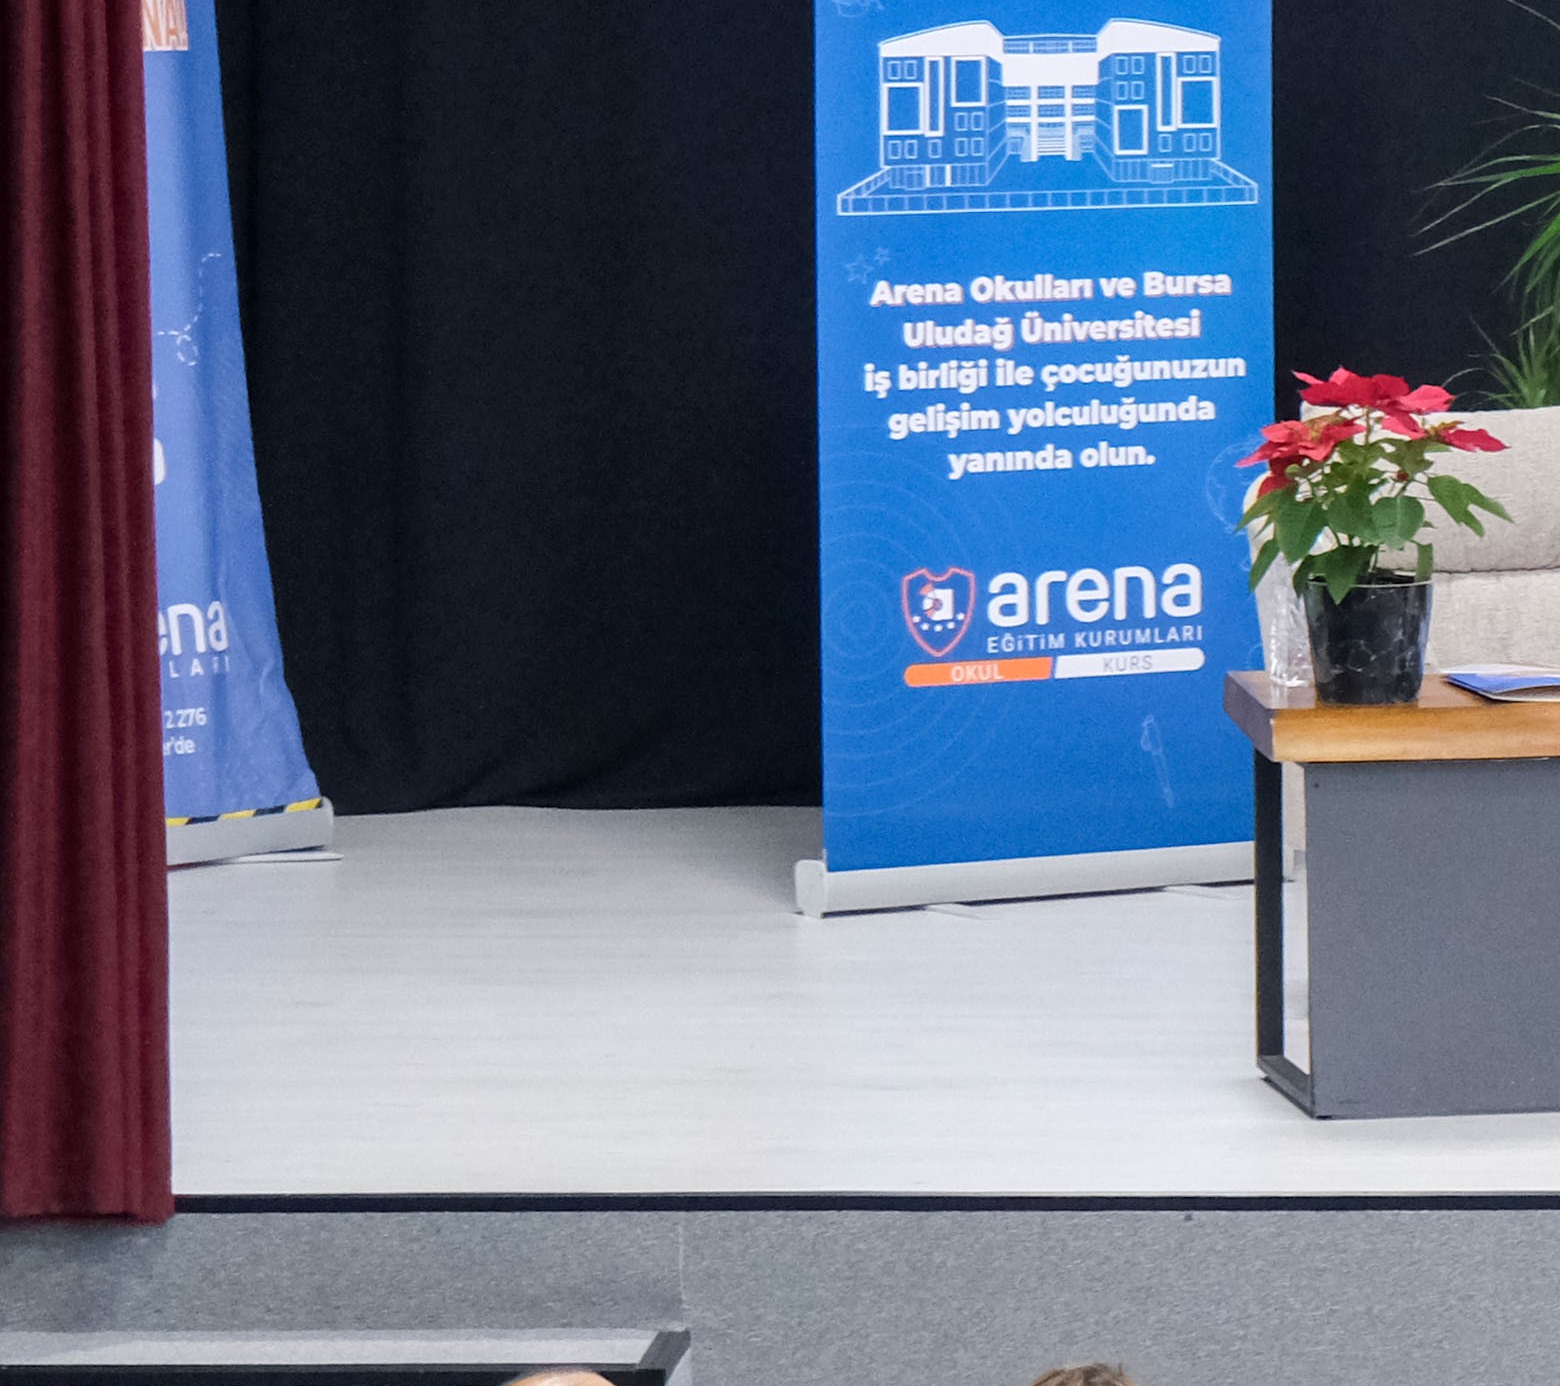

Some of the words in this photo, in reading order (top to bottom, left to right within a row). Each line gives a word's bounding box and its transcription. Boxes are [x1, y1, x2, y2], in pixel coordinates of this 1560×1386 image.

[870, 281, 963, 306] Arena
[970, 274, 1093, 303] Okulları
[1100, 278, 1136, 297] ve
[1144, 272, 1231, 296] Bursa
[904, 317, 1014, 350] Uludağ
[1021, 309, 1200, 343] Üniversitesi
[865, 364, 891, 398] iş
[899, 359, 988, 393] birliği
[996, 359, 1034, 385] ile
[1042, 355, 1245, 391] çocuğunuzun
[889, 403, 1000, 439] gelişim
[1008, 396, 1215, 434] yolculuğunda
[948, 444, 1072, 479] yanında
[1080, 442, 1155, 467] olun.
[988, 564, 1201, 627] arena
[1075, 625, 1203, 649] KURUMLARI
[951, 663, 1004, 682] OKUL
[1103, 655, 1152, 673] KURS
